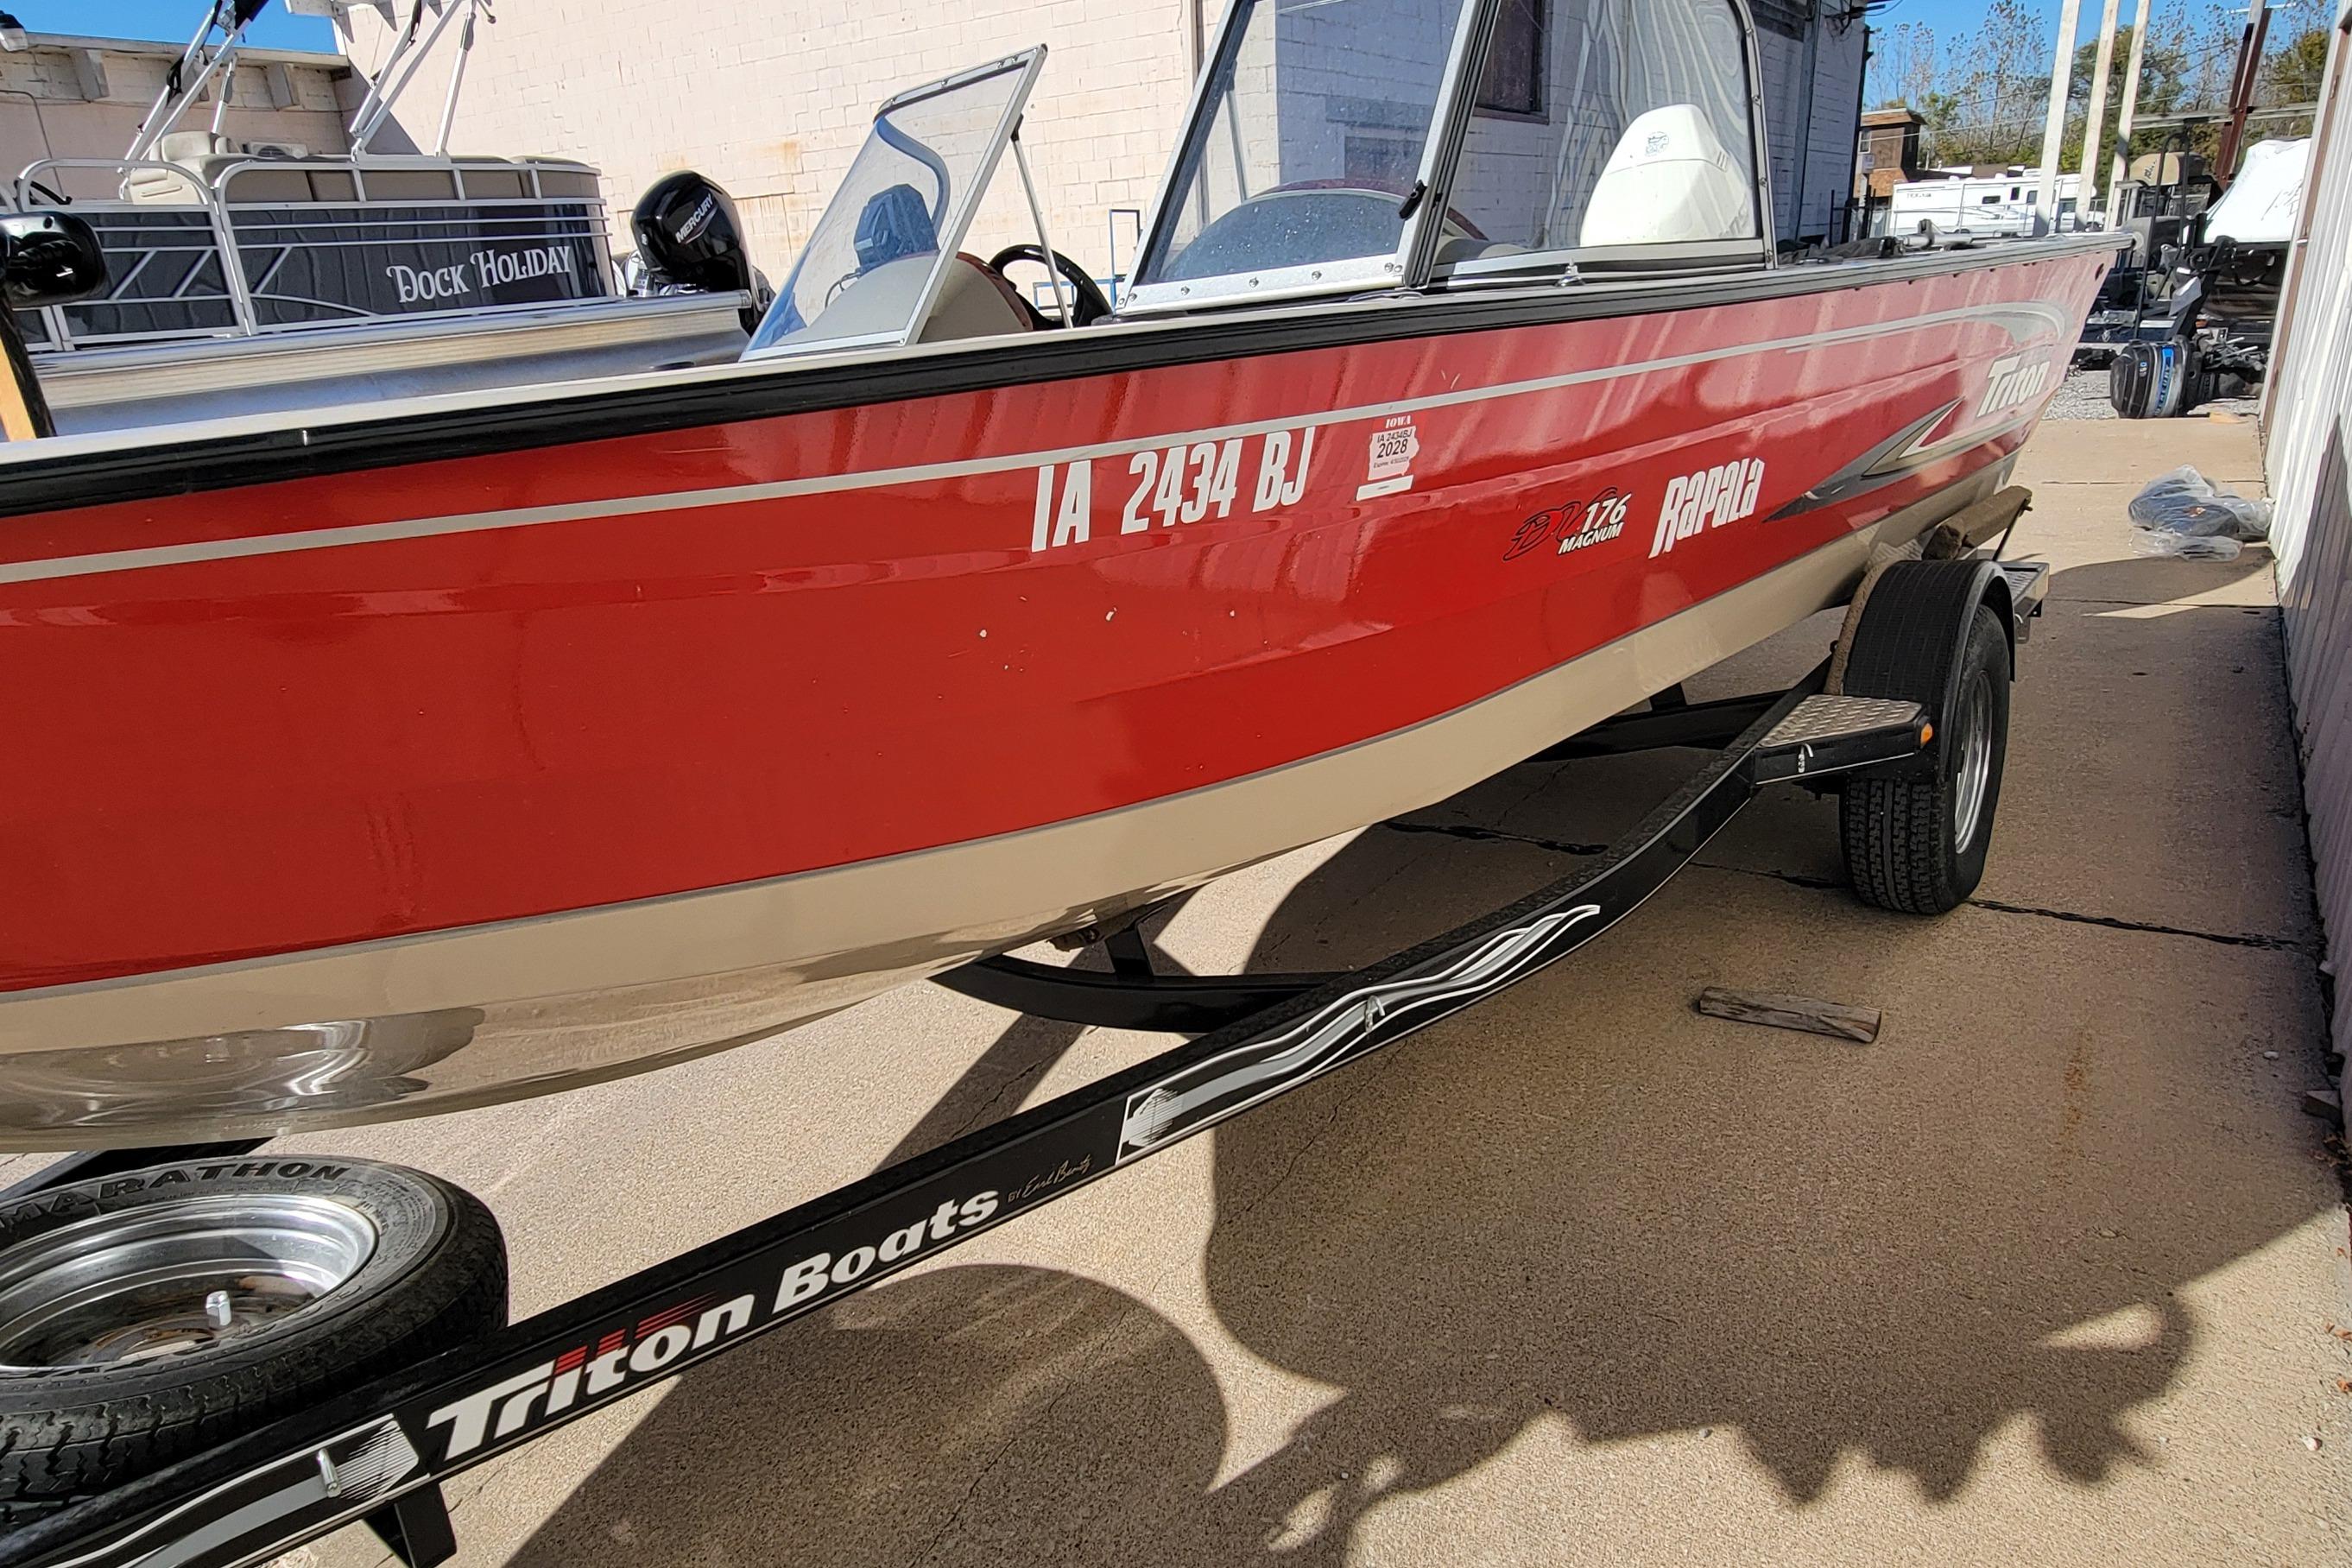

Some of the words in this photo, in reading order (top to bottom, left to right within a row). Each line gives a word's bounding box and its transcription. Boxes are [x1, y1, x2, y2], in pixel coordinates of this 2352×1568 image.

[675, 193, 714, 243] MERCURY
[1976, 355, 2051, 419] Triton
[1385, 415, 1412, 429] IOWA
[1376, 439, 1408, 459] 2028
[1031, 459, 1091, 553] IA
[1121, 438, 1243, 535] 2434
[1252, 427, 1317, 514] BJ
[1581, 492, 1632, 534] 176
[1557, 522, 1625, 556] MAGNUM
[0, 1162, 351, 1230] MARATHON
[426, 1292, 756, 1461] Triton
[772, 1188, 1000, 1315] Boats
